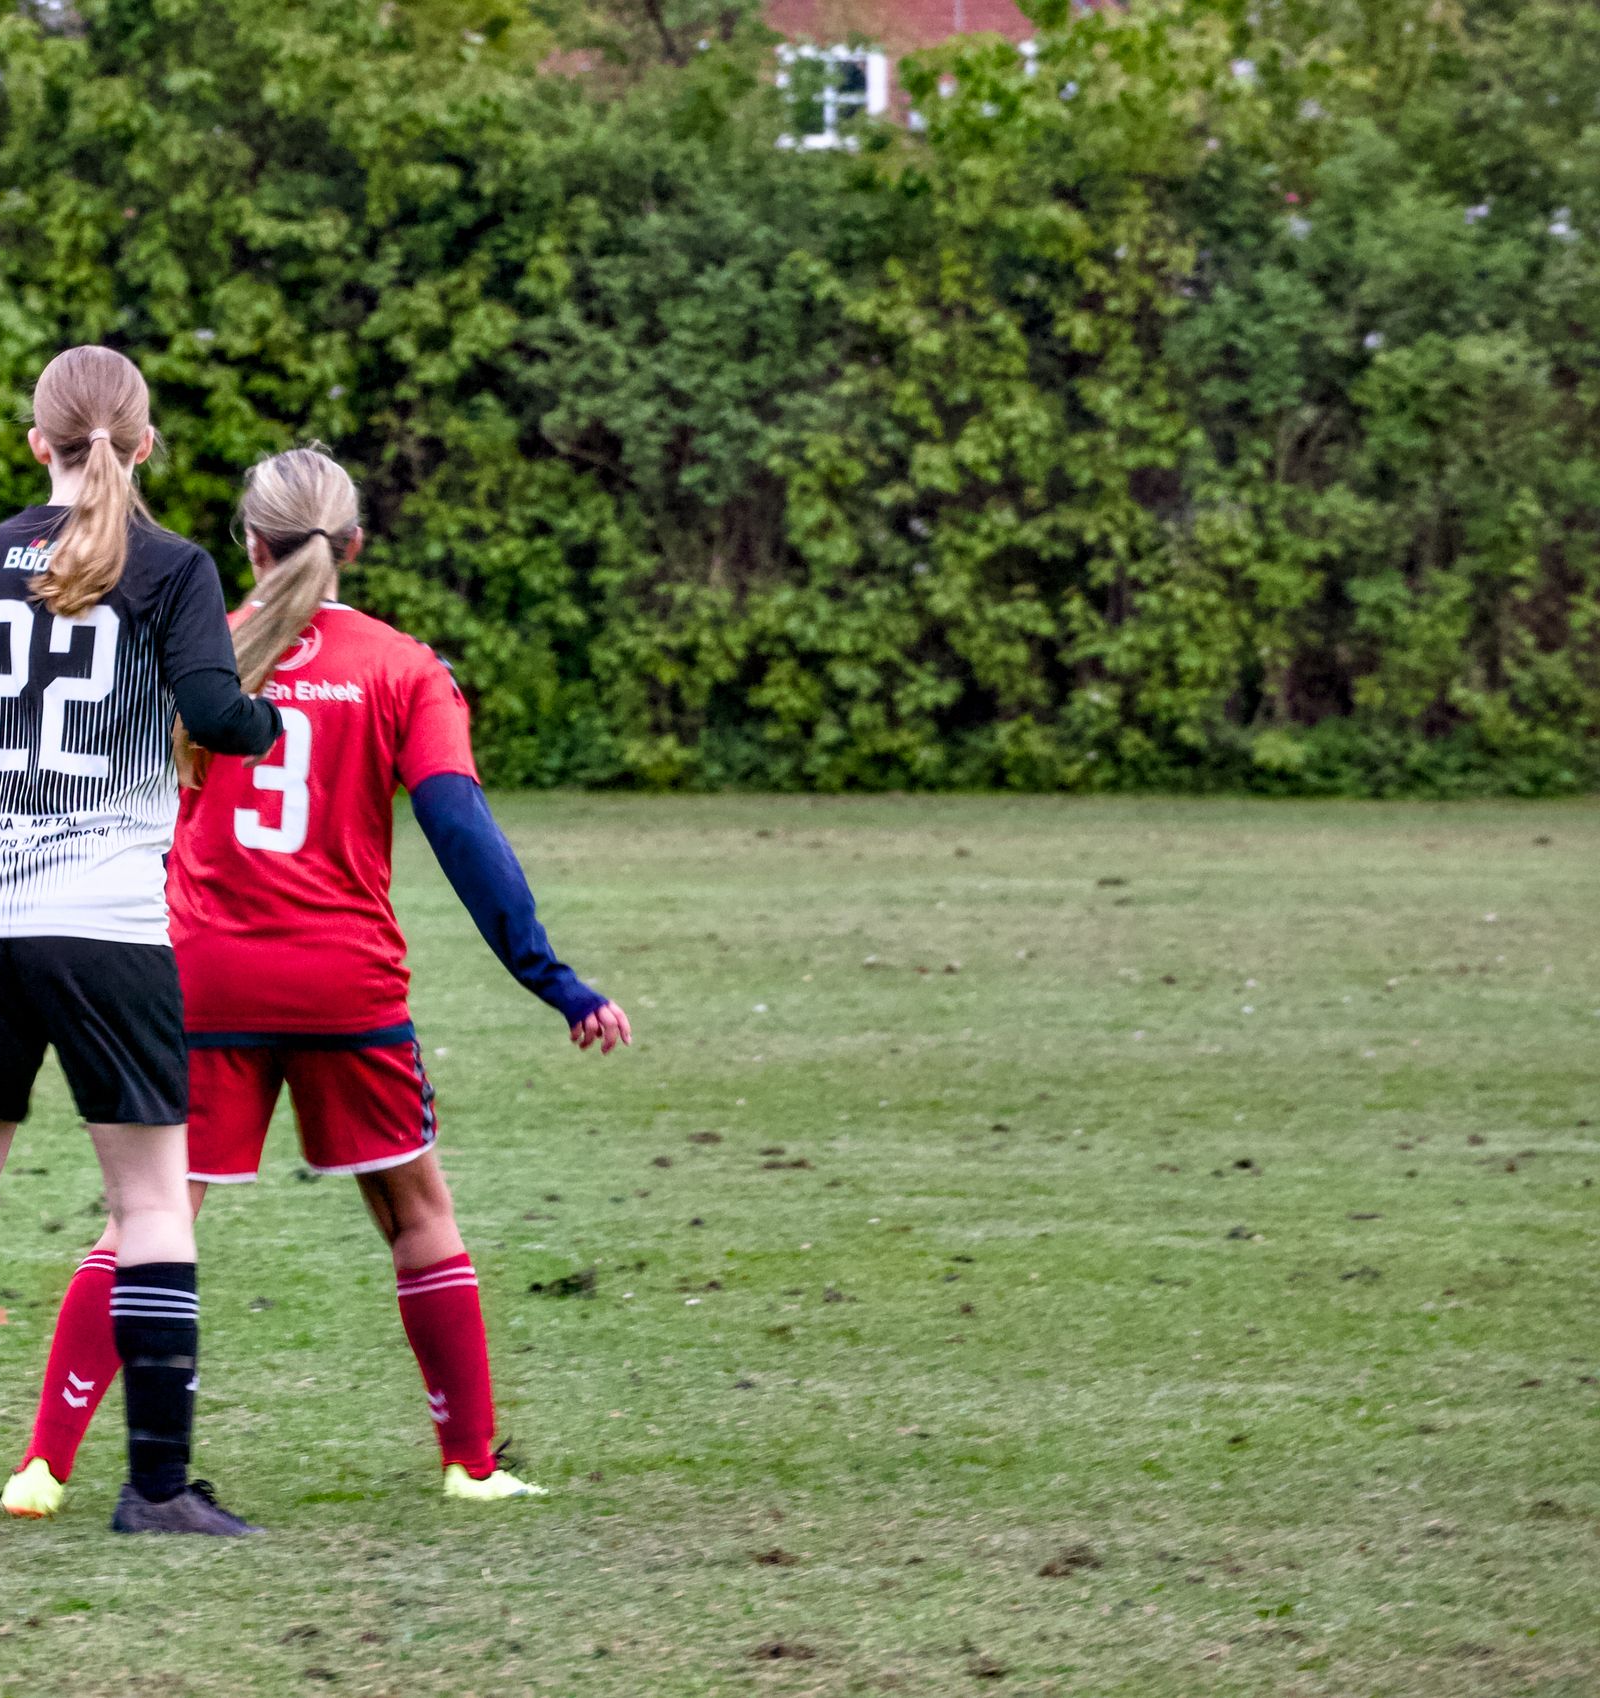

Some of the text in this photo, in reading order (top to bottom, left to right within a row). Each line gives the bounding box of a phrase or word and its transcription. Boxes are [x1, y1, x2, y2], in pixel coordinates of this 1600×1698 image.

[295, 679, 364, 703] Enkelt
[234, 707, 312, 854] 3
[31, 816, 78, 829] METAL
